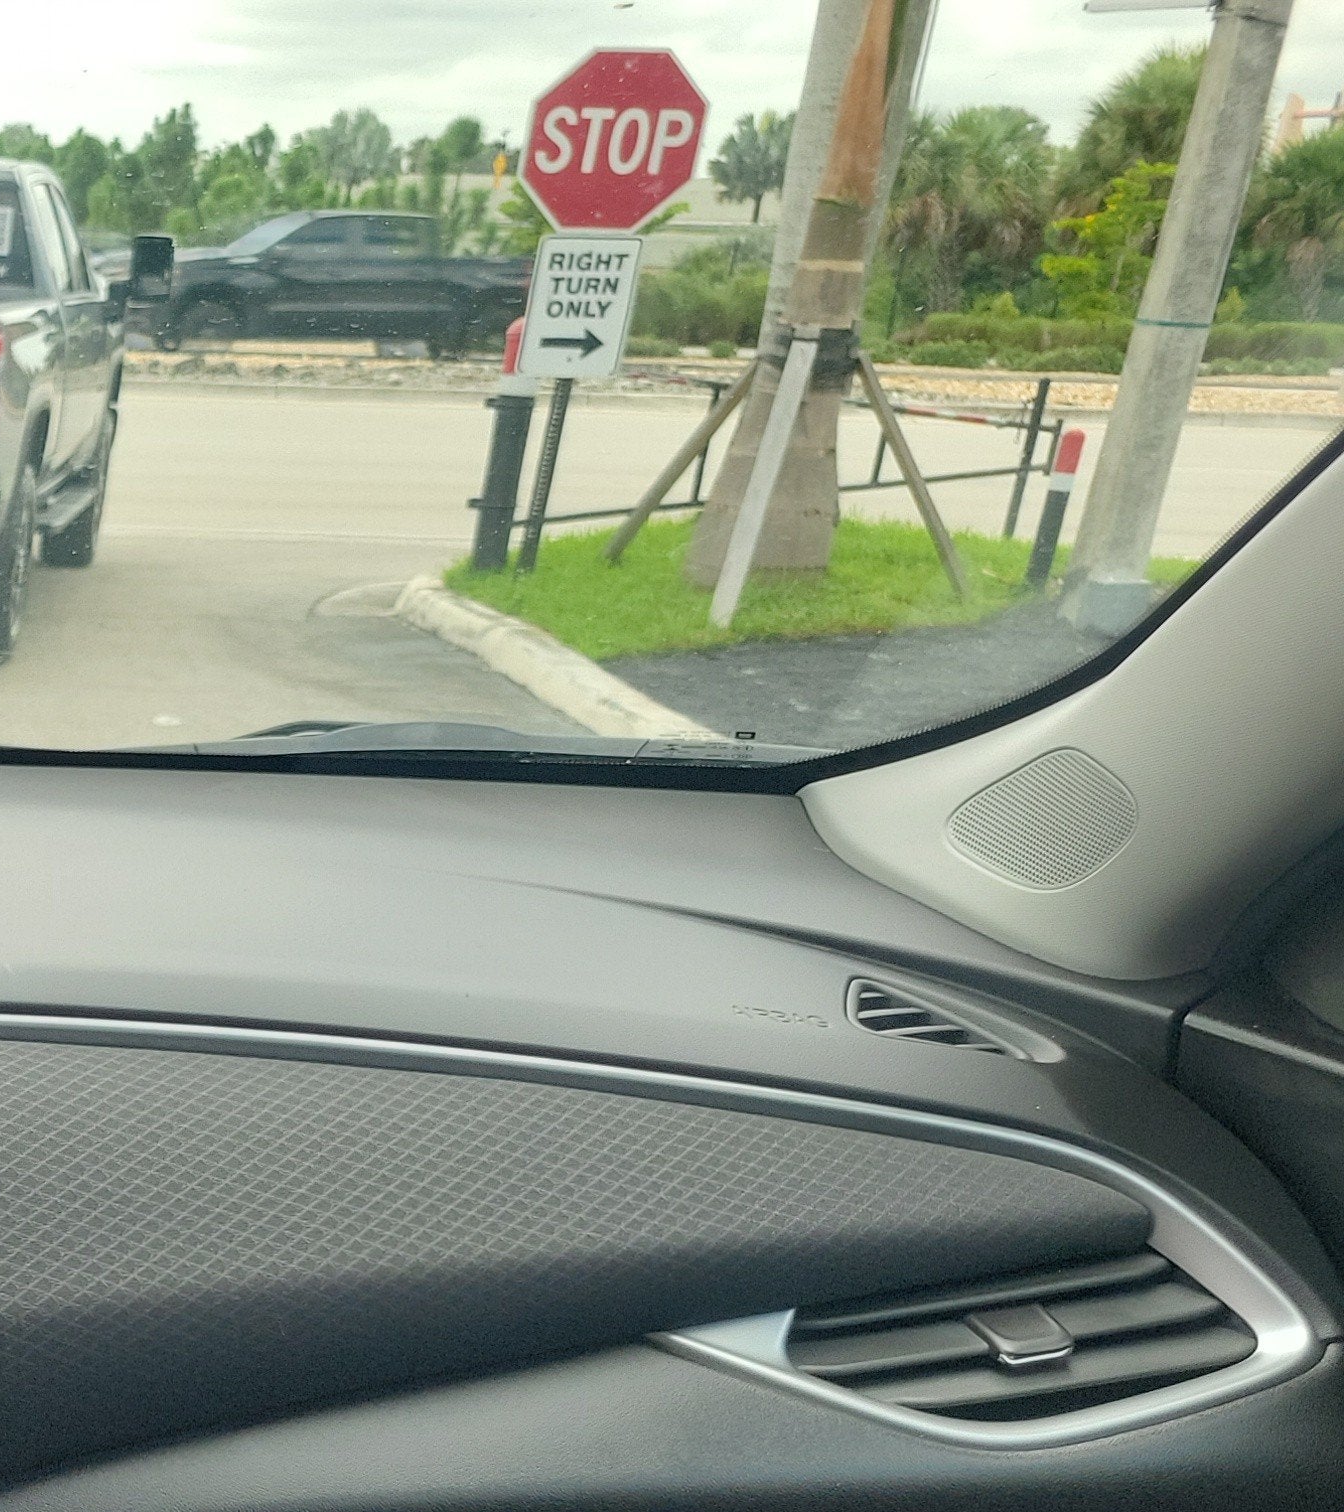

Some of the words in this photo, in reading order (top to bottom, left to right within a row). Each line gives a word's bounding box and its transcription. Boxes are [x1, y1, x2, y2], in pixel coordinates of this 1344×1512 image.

[534, 106, 695, 176] STOP
[548, 251, 629, 272] RIGHT
[549, 277, 619, 295] TURN
[546, 299, 613, 319] ONLY
